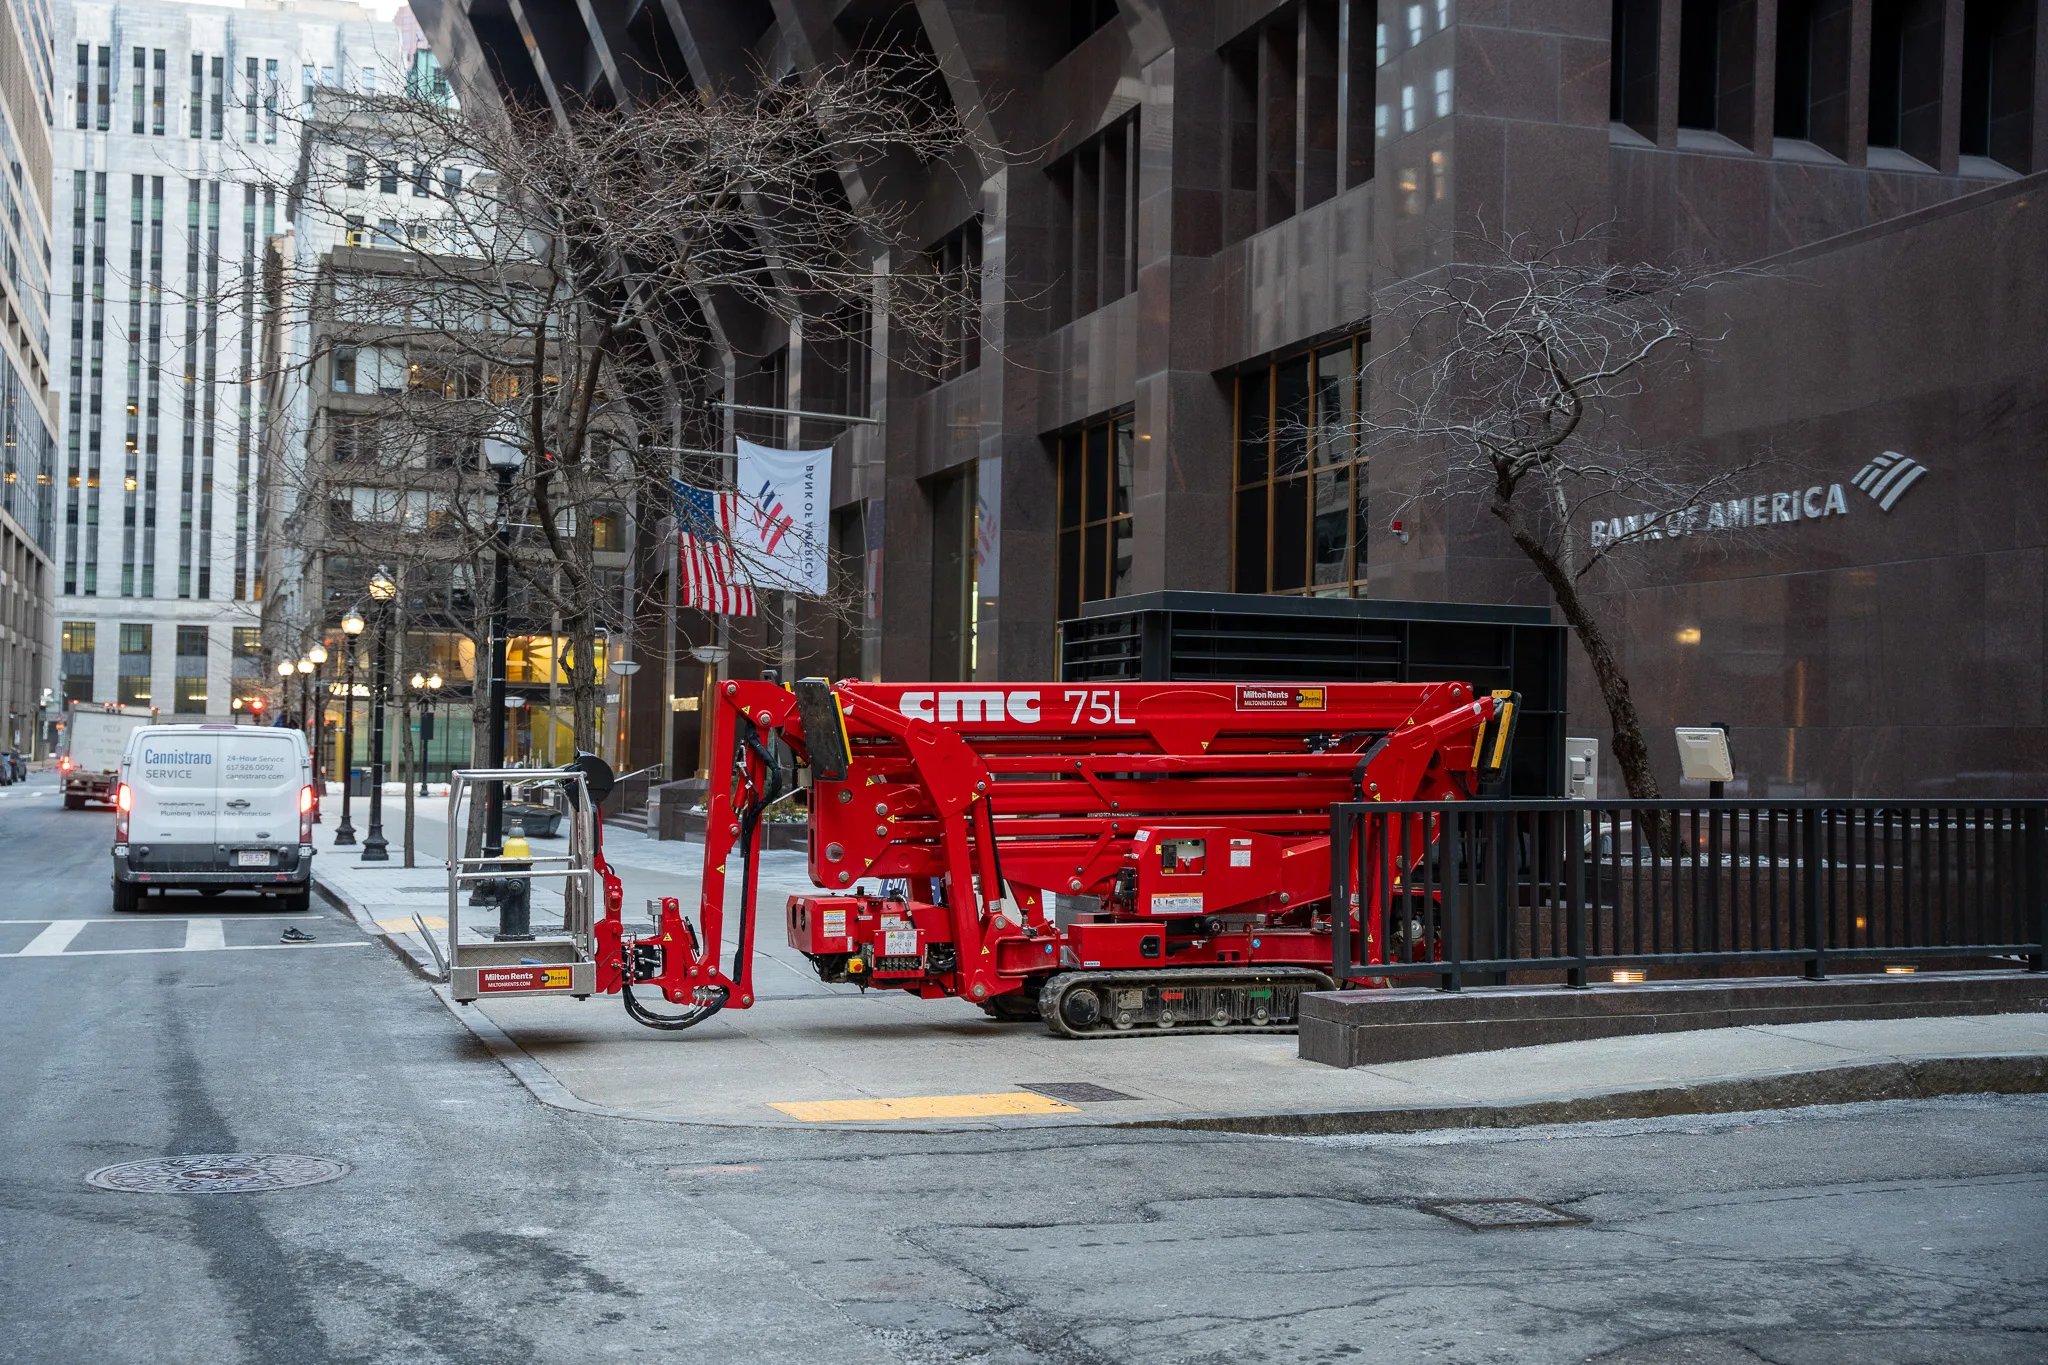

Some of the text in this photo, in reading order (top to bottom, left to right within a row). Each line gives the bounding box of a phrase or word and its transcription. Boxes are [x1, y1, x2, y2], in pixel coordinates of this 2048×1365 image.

[1706, 483, 1849, 530] AMERICA
[1243, 690, 1289, 699] Milton Rents
[145, 749, 211, 765] Cannistraro
[259, 755, 285, 763] Service
[145, 769, 192, 779] SERVICE
[484, 972, 534, 981] Milton Rents
[487, 980, 531, 988] MILTONRENTS.COM
